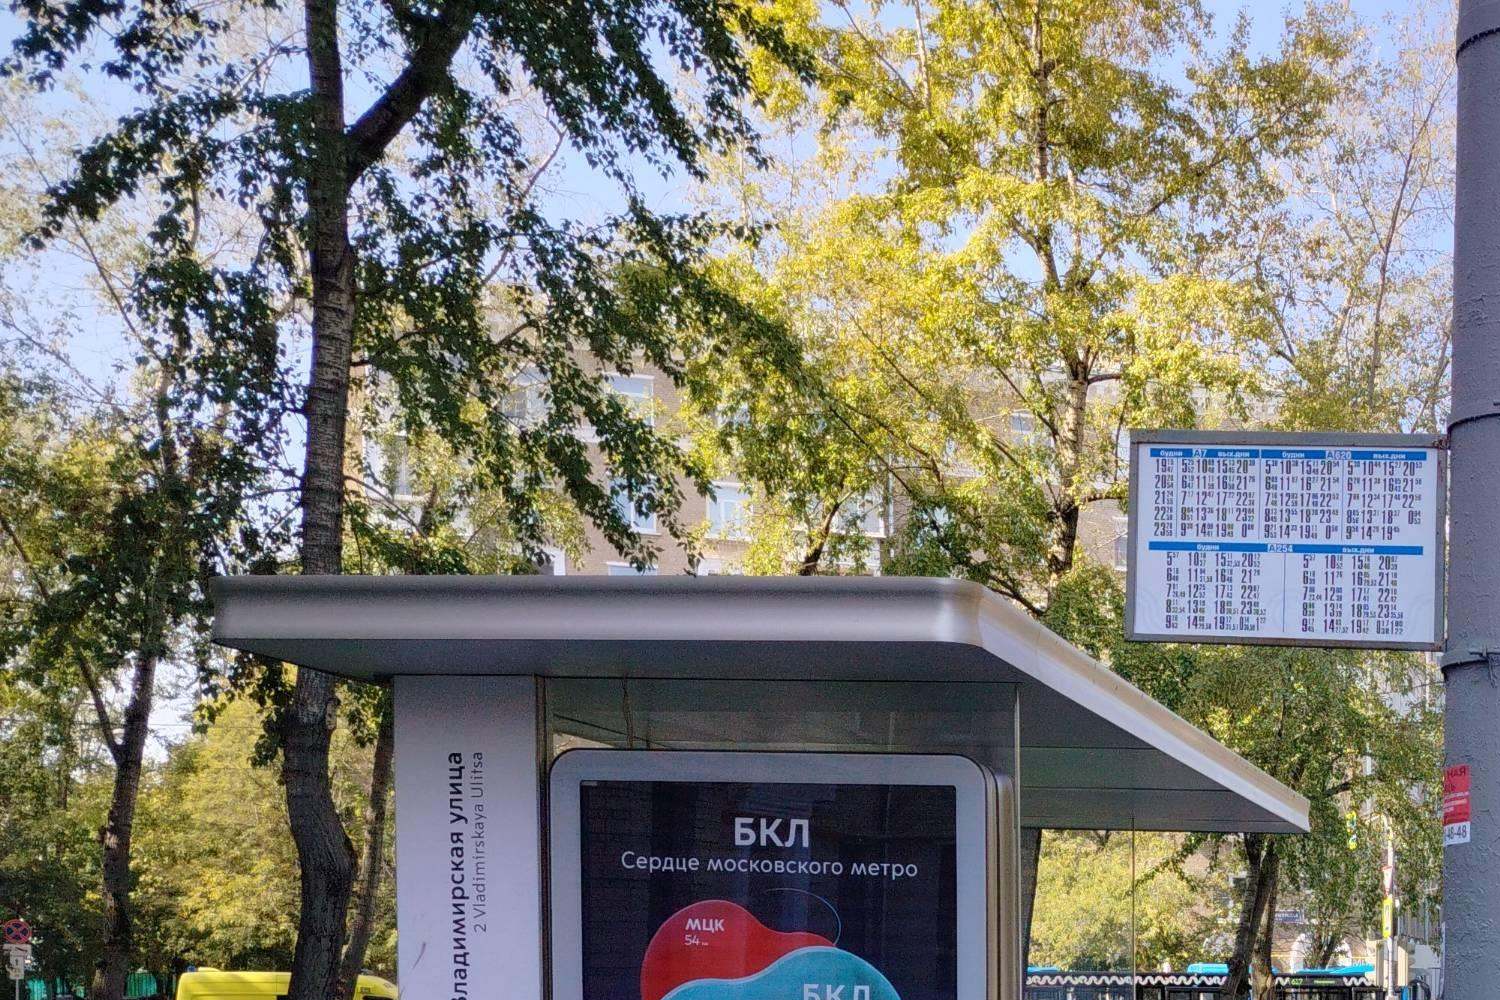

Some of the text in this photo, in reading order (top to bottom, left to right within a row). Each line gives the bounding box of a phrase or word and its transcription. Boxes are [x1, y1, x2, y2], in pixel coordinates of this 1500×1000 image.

[447, 752, 469, 825] улица
[469, 752, 487, 932] 2 Vladimirskaya Ulitsa
[734, 816, 810, 848] БКЛ
[621, 851, 918, 880] Сердце московского метро
[684, 934, 700, 946] 54
[685, 918, 725, 934] МЦК
